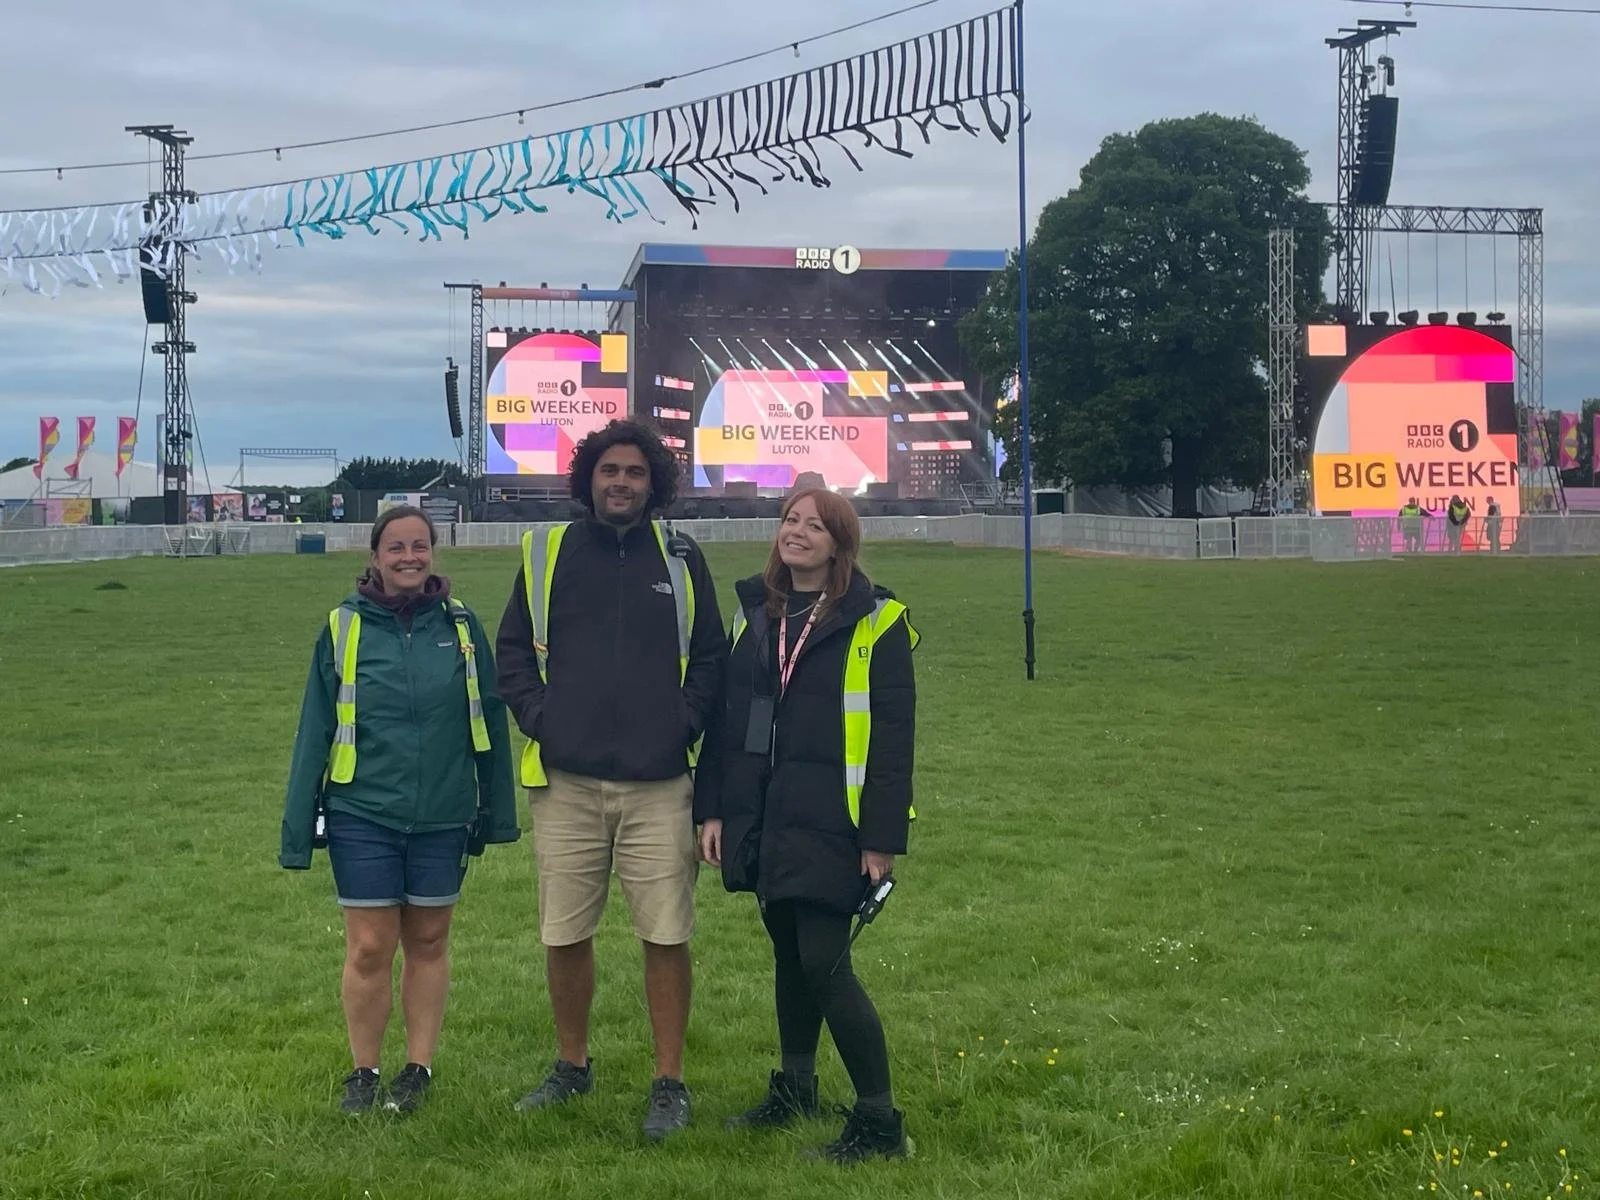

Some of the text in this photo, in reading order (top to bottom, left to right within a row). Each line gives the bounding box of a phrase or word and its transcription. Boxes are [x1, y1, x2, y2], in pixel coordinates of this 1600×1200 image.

[796, 260, 830, 269] RADIO
[497, 400, 617, 414] BIG WEEKEND
[541, 418, 573, 426] LUTON
[722, 425, 860, 441] BIG WEEKEND
[1407, 425, 1444, 436] BBC
[1407, 438, 1445, 448] RADIO
[772, 445, 810, 455] LUTON
[1333, 462, 1387, 488] BIG
[1416, 496, 1476, 512] UTN
